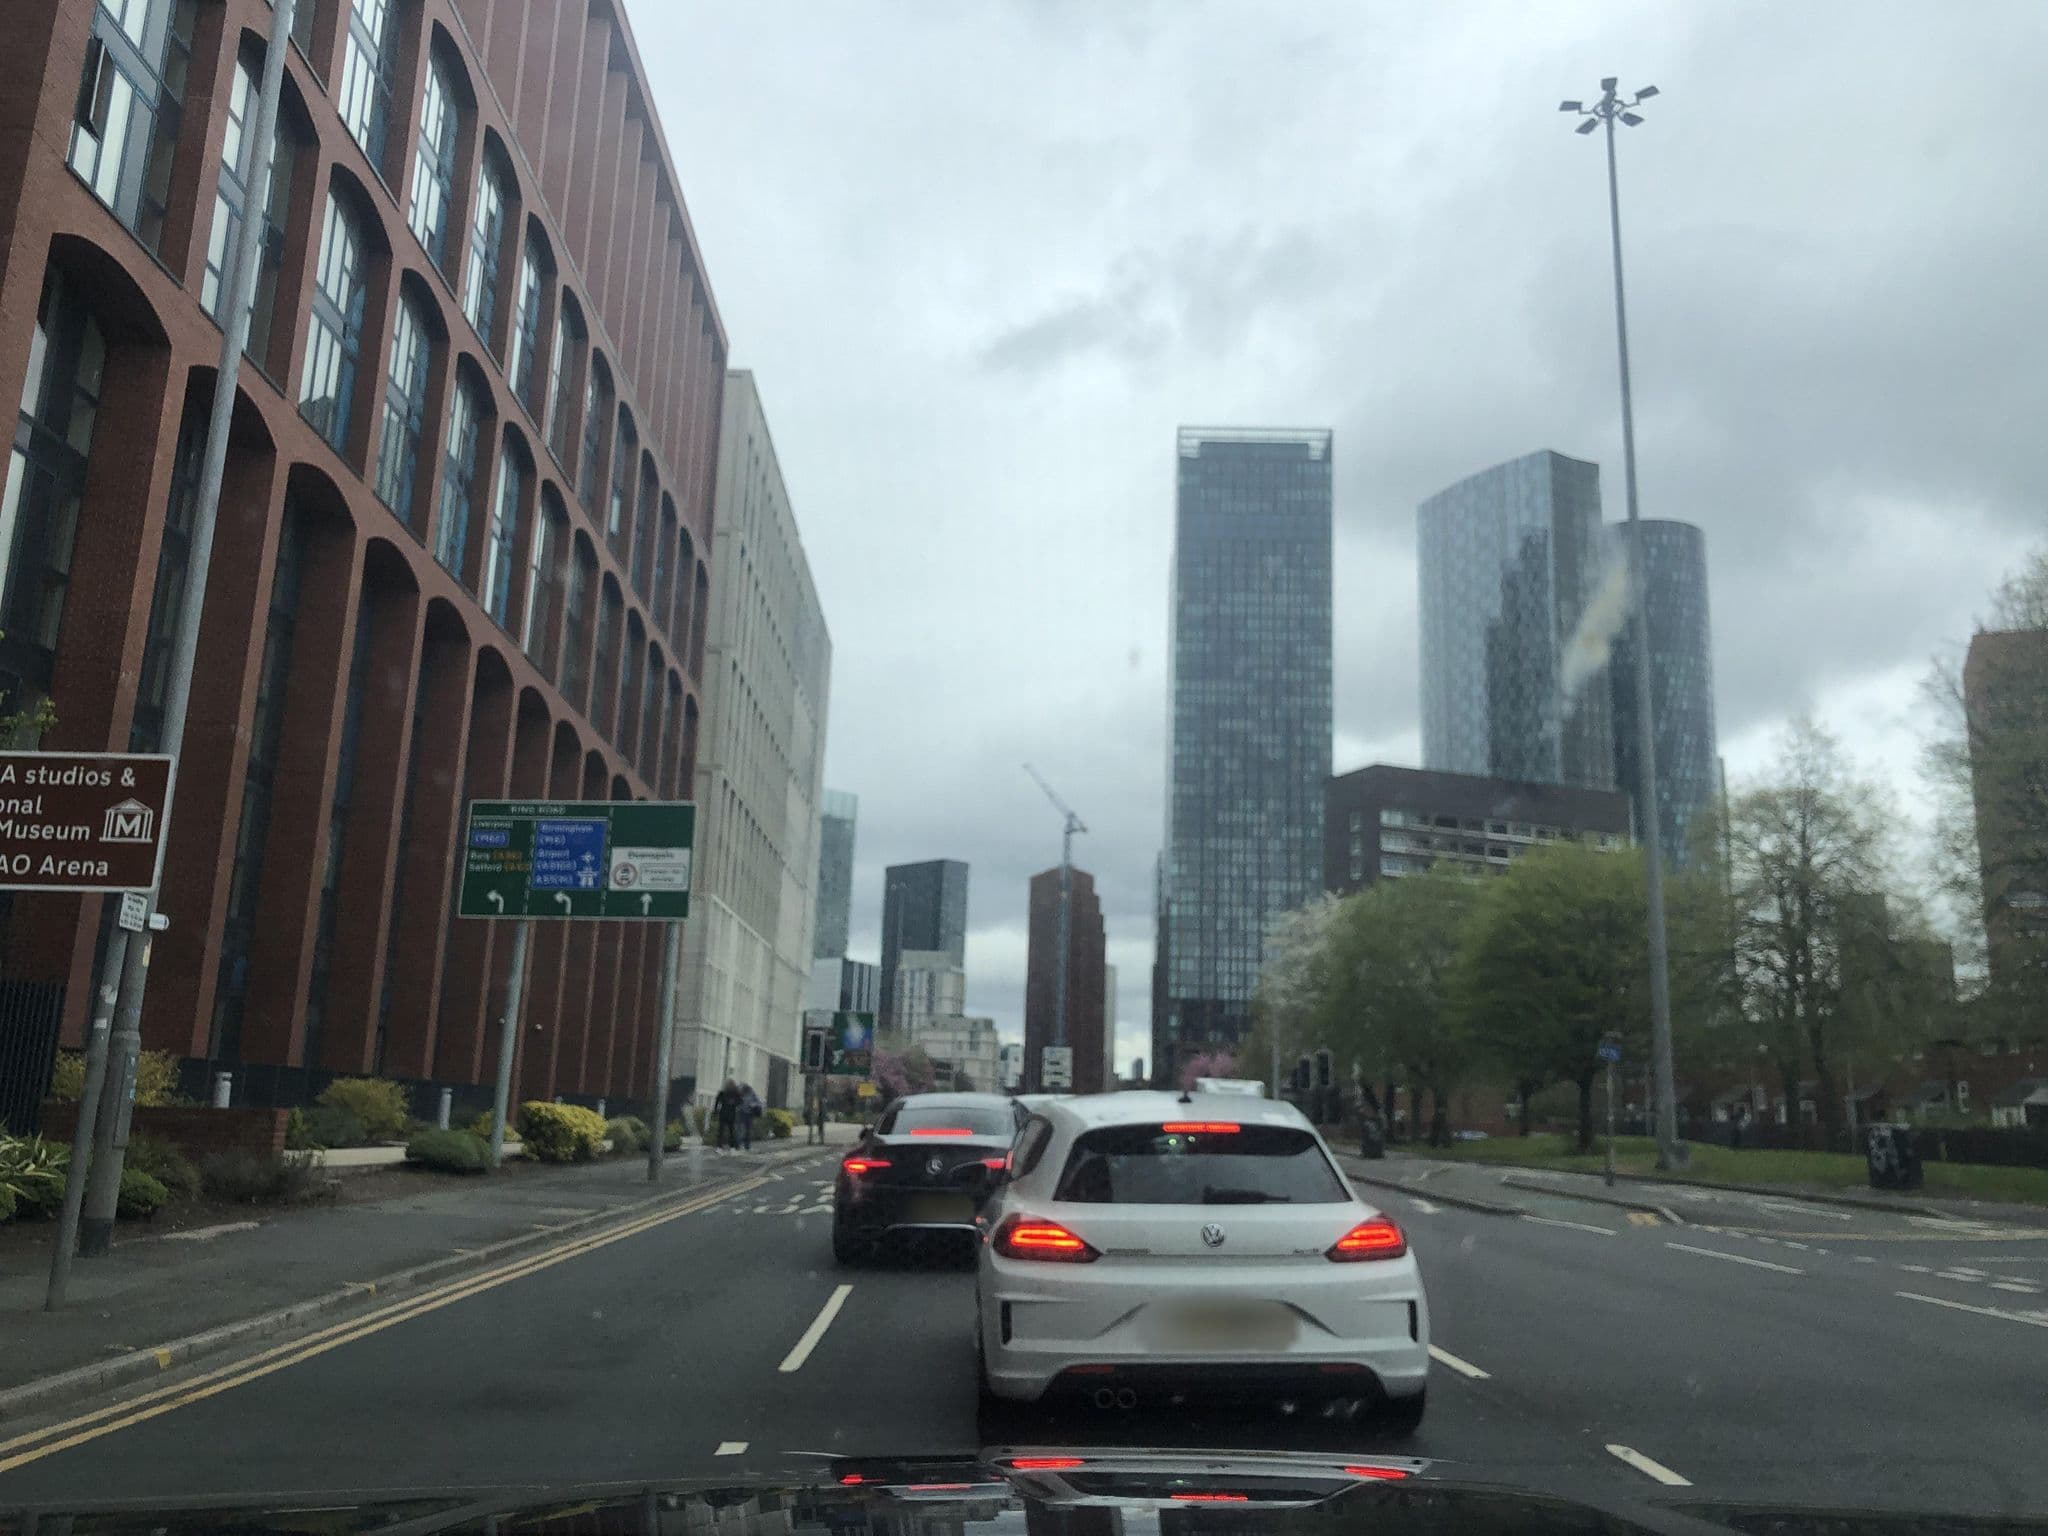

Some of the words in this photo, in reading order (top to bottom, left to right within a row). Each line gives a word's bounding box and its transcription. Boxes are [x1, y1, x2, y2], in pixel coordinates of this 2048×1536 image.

[25, 765, 113, 787] studios
[121, 767, 136, 788] &
[0, 794, 43, 815] nal
[0, 819, 91, 841] Museum
[38, 855, 109, 877] Arena
